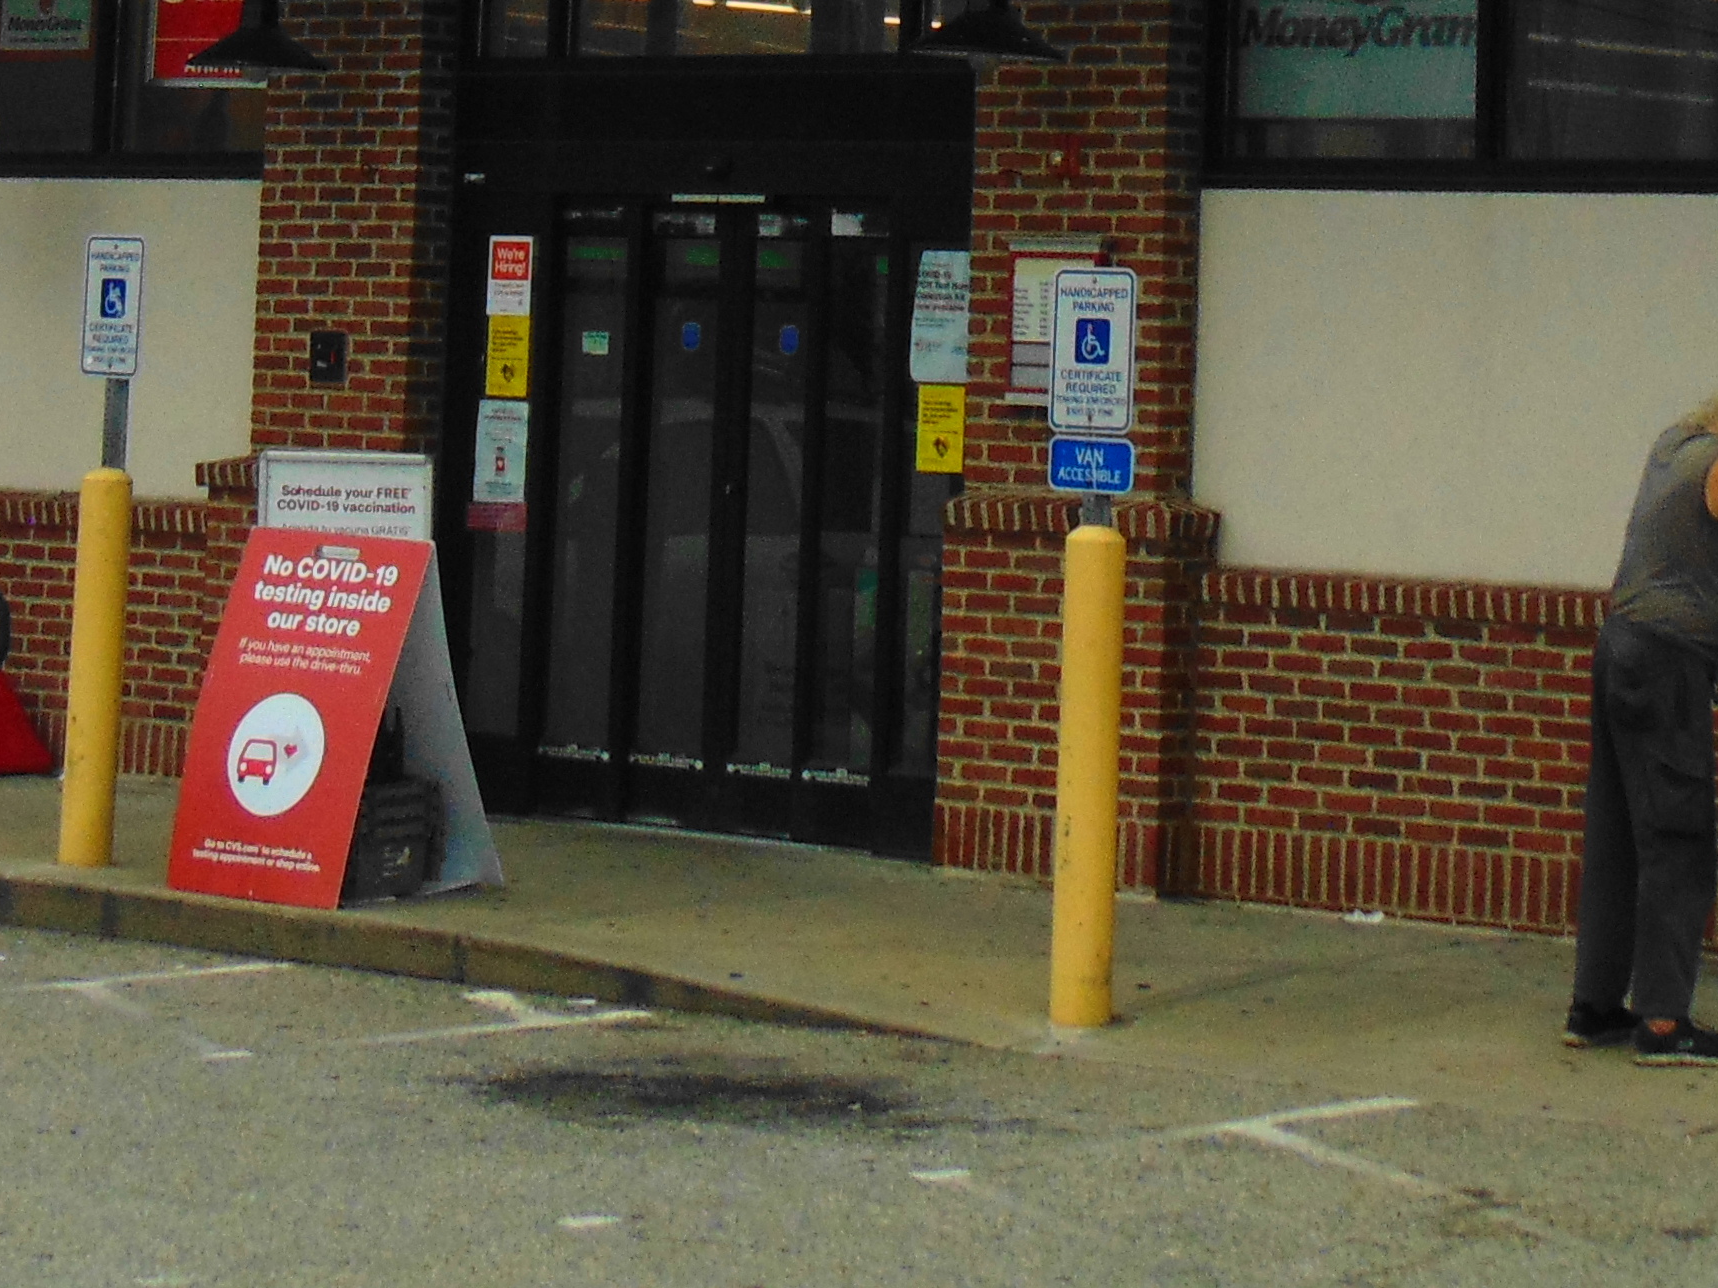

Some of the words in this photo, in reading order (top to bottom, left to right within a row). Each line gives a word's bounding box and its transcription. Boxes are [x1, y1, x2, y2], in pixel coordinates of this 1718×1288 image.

[497, 247, 525, 261] We're
[494, 260, 526, 276] Hiring!
[1060, 286, 1128, 299] HANDICAPPED
[1072, 301, 1115, 313] PARKING
[1060, 369, 1122, 383] CERTIFICATE
[1065, 382, 1117, 396] REQUIRED
[1075, 446, 1105, 466] VAN
[1057, 466, 1122, 485] ACCESSIBLE
[281, 484, 342, 497] Schedule
[344, 488, 374, 501] your
[276, 499, 340, 513] COVID-19
[342, 501, 416, 514] vaccination
[263, 554, 294, 577] No
[296, 556, 400, 587] COVID-19
[254, 580, 325, 611] testing
[326, 585, 392, 613] inside
[267, 611, 304, 630] our
[304, 613, 361, 637] store
[238, 637, 249, 649] If
[248, 640, 266, 653] you
[267, 640, 290, 653] have
[290, 643, 305, 655] an
[238, 651, 273, 665] please
[273, 655, 291, 667] use
[291, 654, 309, 669] the
